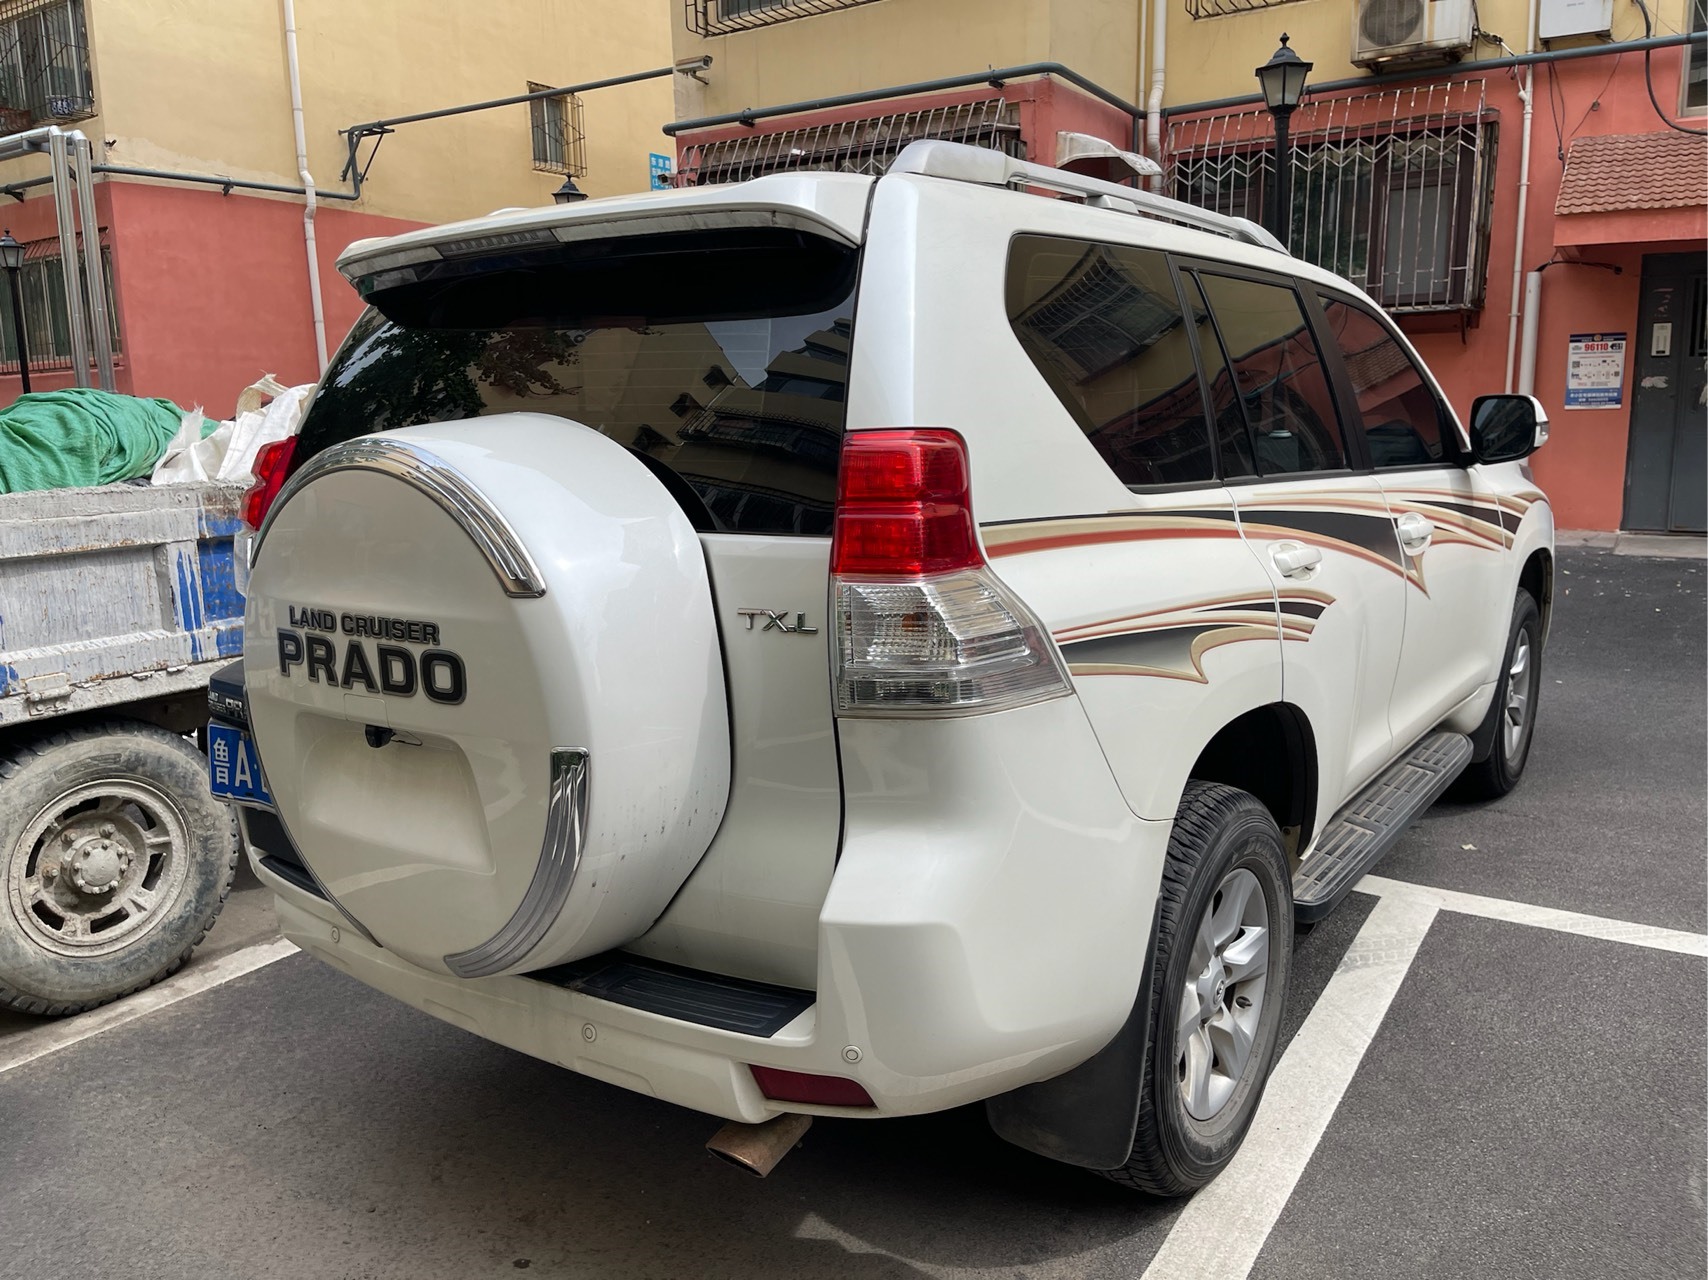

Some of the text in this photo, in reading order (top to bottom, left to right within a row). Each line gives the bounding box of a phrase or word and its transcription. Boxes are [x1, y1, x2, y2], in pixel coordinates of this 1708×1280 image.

[1584, 343, 1608, 351] 96110
[289, 605, 440, 646] LAND CRUISER
[277, 627, 467, 706] PRADO
